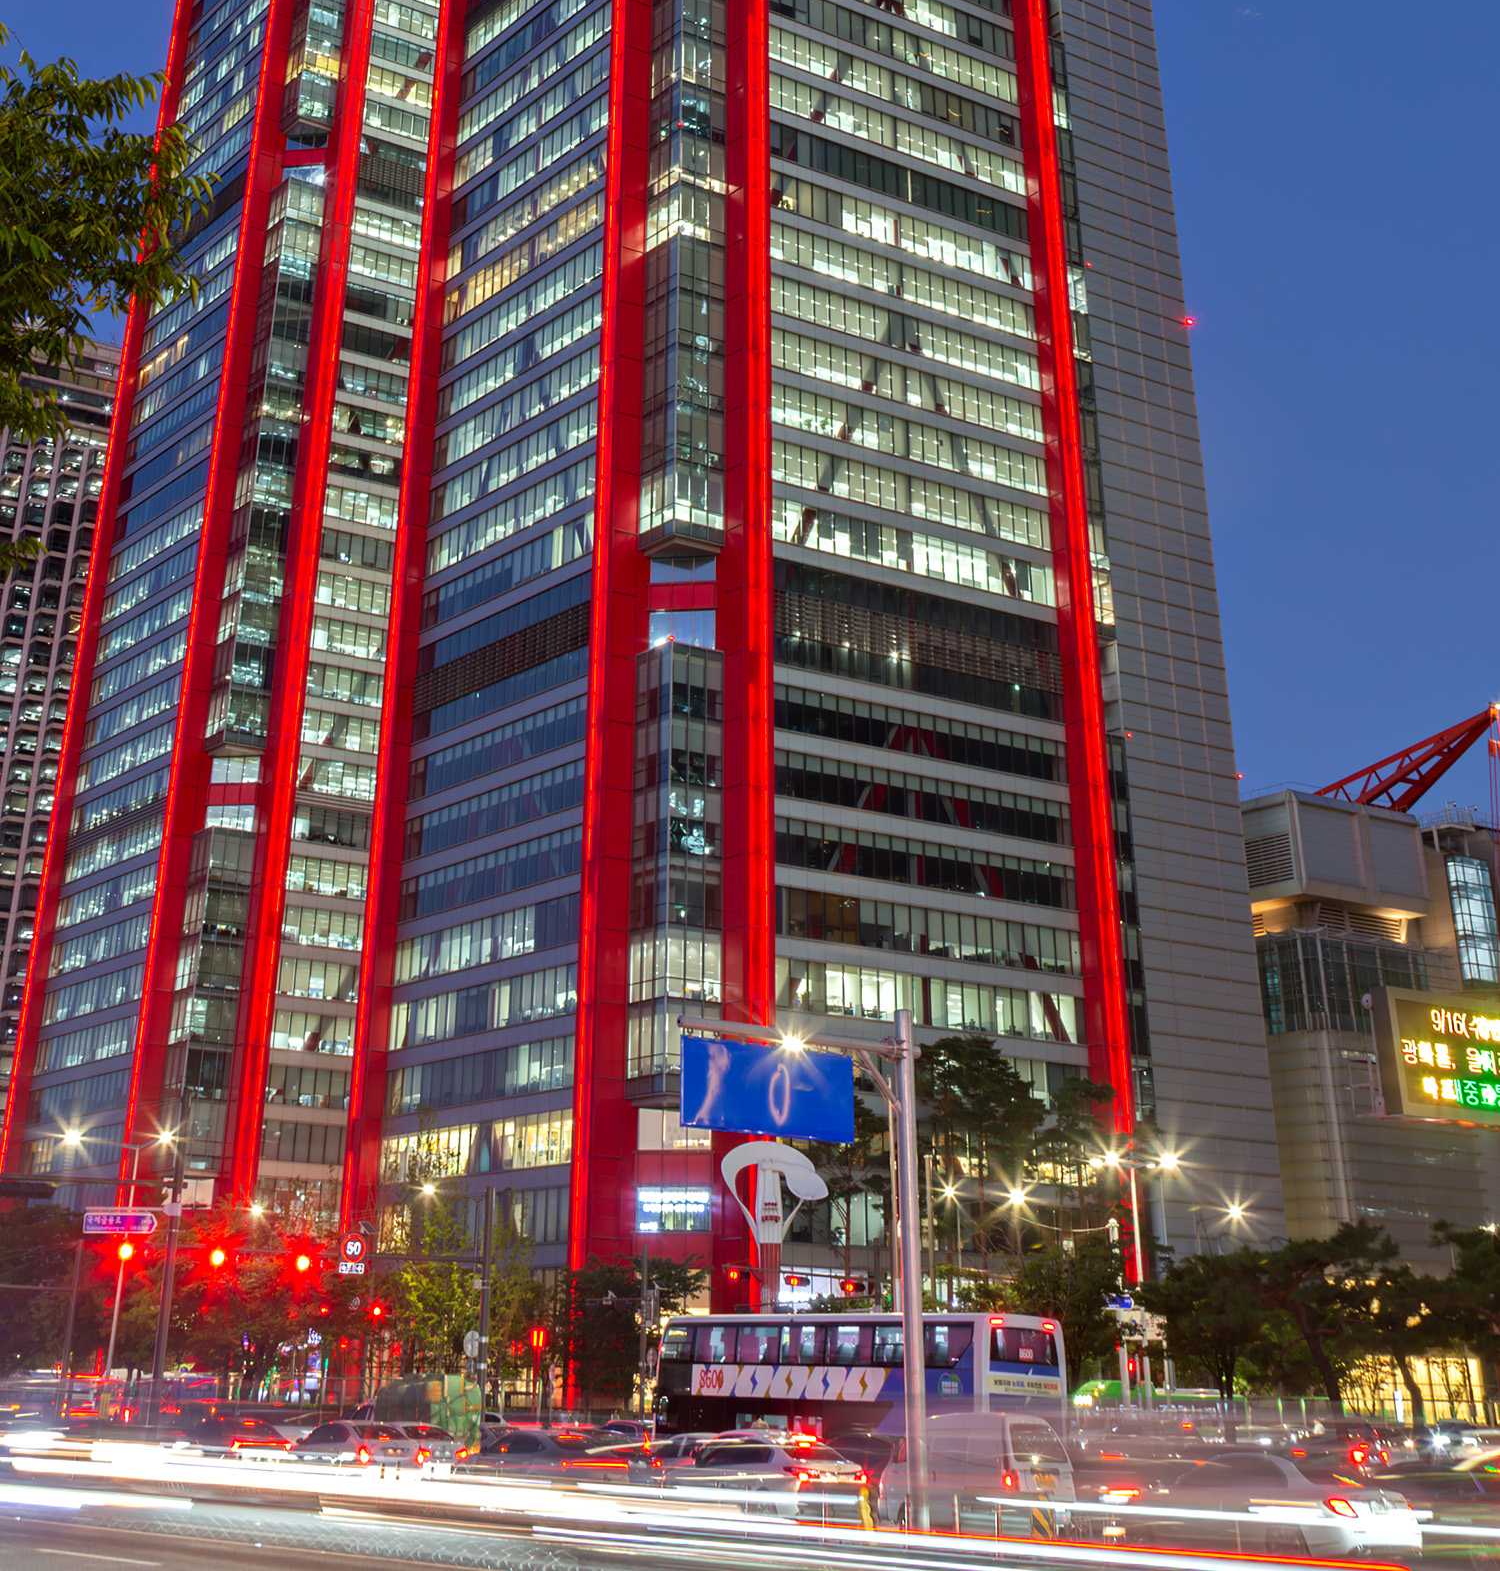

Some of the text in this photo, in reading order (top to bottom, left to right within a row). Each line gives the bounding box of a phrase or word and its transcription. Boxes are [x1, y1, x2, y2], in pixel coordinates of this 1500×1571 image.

[346, 1241, 361, 1255] 50
[1019, 1348, 1033, 1359] 8600
[700, 1369, 724, 1389] 8600
